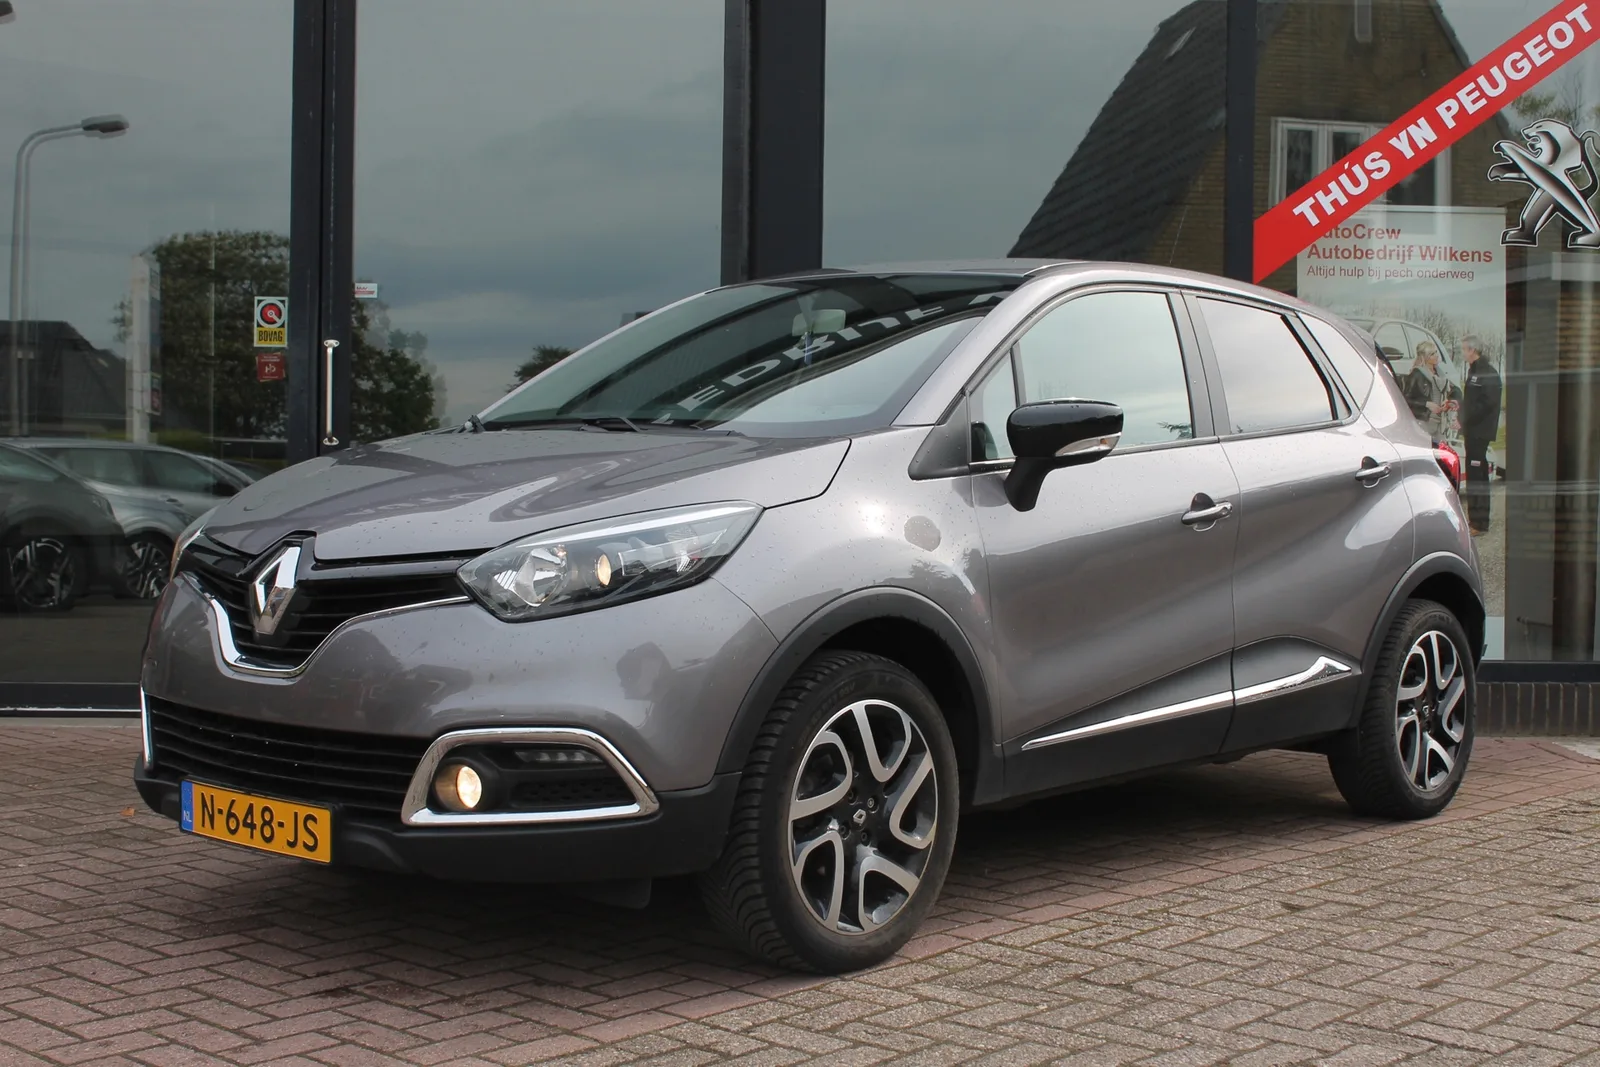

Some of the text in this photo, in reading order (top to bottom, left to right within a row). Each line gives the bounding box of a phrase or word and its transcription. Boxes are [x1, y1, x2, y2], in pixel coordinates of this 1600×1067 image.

[1292, 3, 1593, 228] THÚS YN PEUGEOT
[1307, 244, 1493, 265] Autobedrijf Wilkens
[1307, 265, 1474, 282] Altijd hulp bij pech onderweg
[258, 330, 283, 342] BOVAG
[201, 792, 319, 853] N-648-JS
